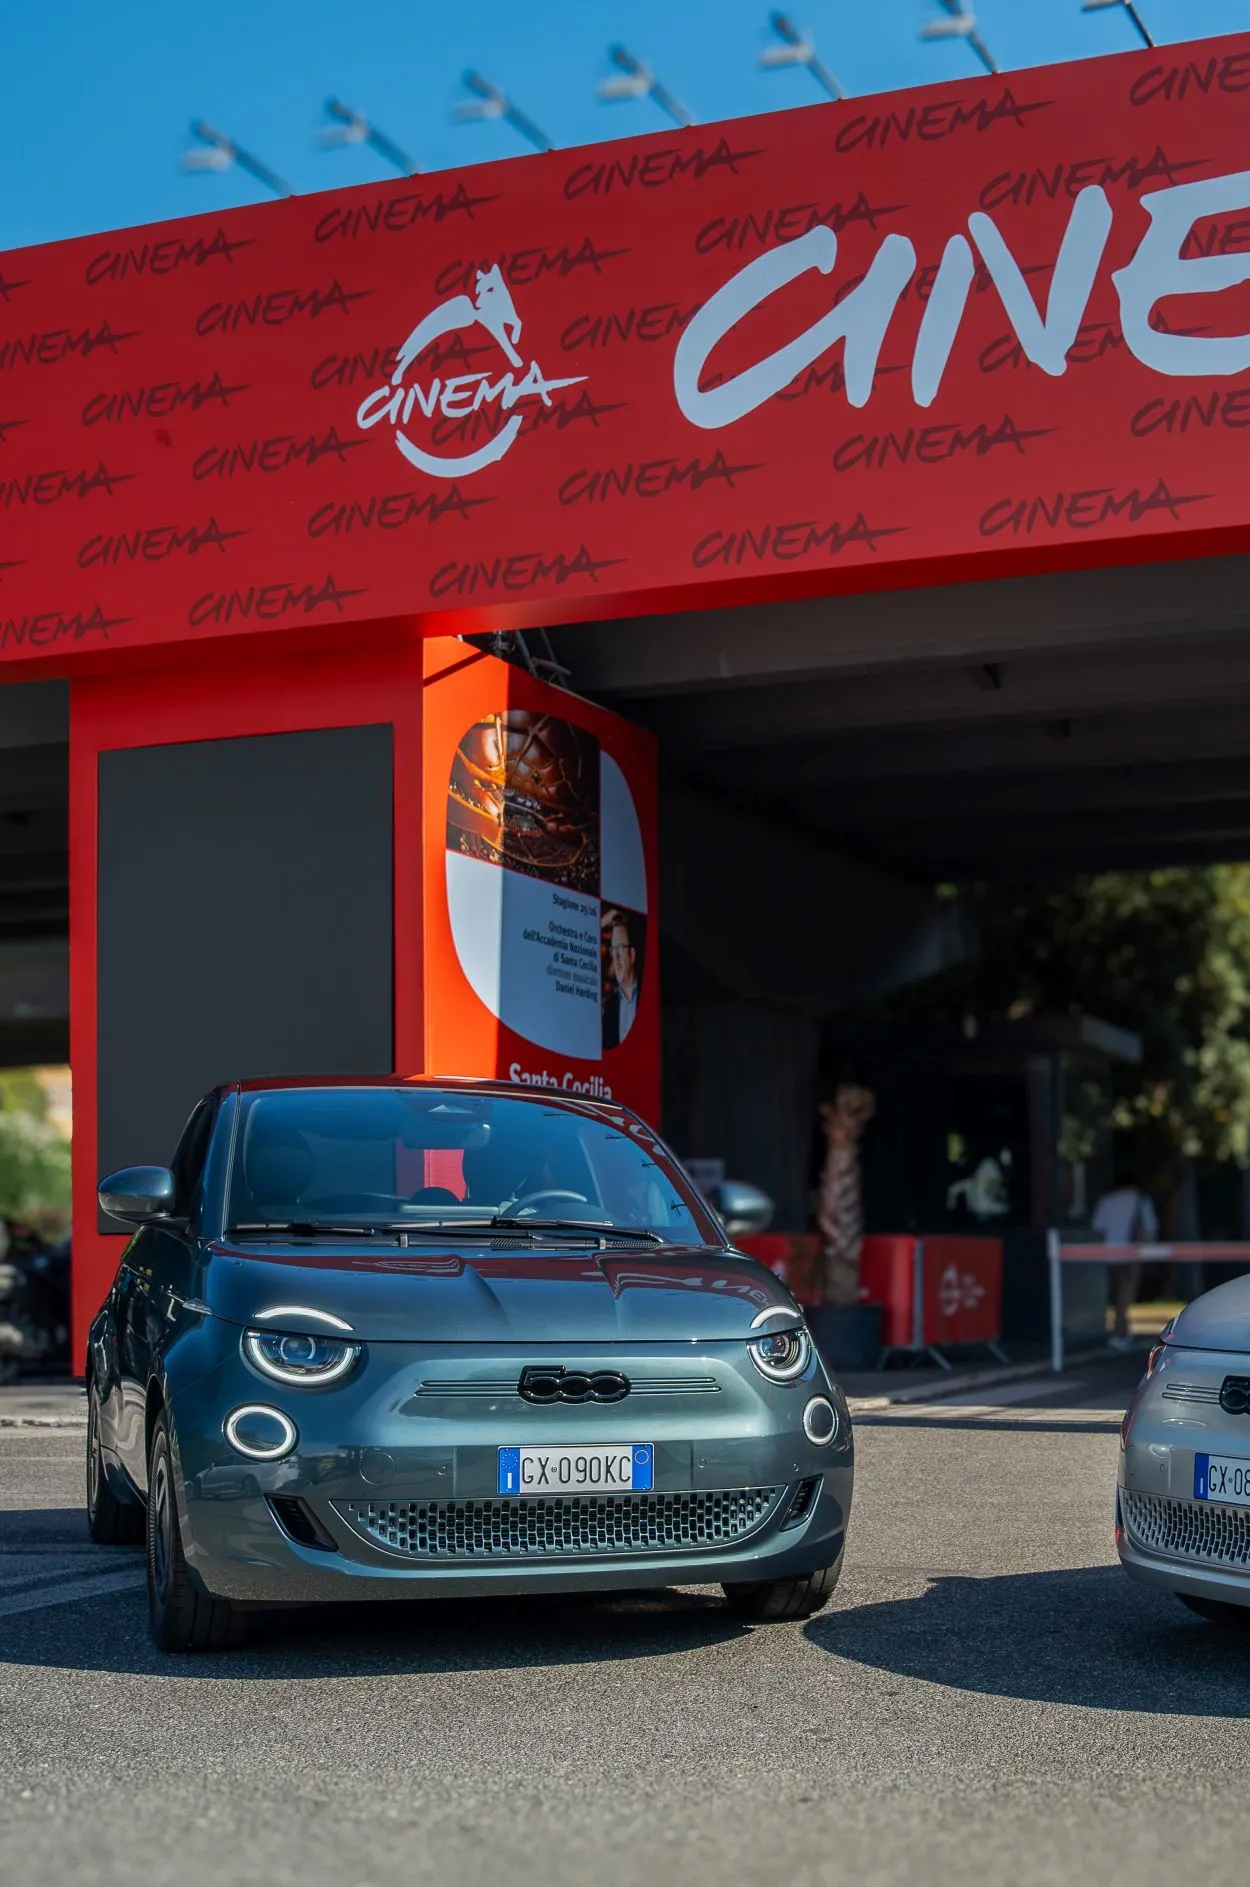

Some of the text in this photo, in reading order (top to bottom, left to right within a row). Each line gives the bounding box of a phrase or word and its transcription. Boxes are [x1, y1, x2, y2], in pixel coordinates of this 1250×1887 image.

[834, 87, 1057, 153] CINEMA
[563, 137, 768, 199] CINEMA
[979, 145, 1211, 211] CINEMA
[314, 183, 500, 243] CINEMA
[694, 191, 909, 254] CINEMA
[86, 228, 257, 286] CINEMA
[195, 279, 375, 336] CINEMA
[561, 302, 765, 351] CINEM
[0, 321, 141, 370] INEMA
[81, 372, 251, 428] CINEMA
[357, 360, 590, 429] CINEMA
[191, 426, 372, 482] CINEMA
[832, 412, 1059, 472] CINEMA
[0, 462, 138, 509] NEMA
[557, 448, 765, 505] CINEMA
[308, 483, 498, 540] CINEMA
[978, 478, 1216, 537] CINEMA
[78, 517, 249, 568] CINEMA
[691, 511, 909, 569] CINEMA
[429, 544, 627, 597] CINEMA
[0, 604, 136, 651] NEMA
[189, 575, 371, 628] CINEMA
[548, 921, 578, 940] Orchestra
[553, 952, 560, 963] di
[561, 953, 577, 968] Santa
[556, 981, 574, 995] Daniel
[517, 1365, 632, 1406] 500
